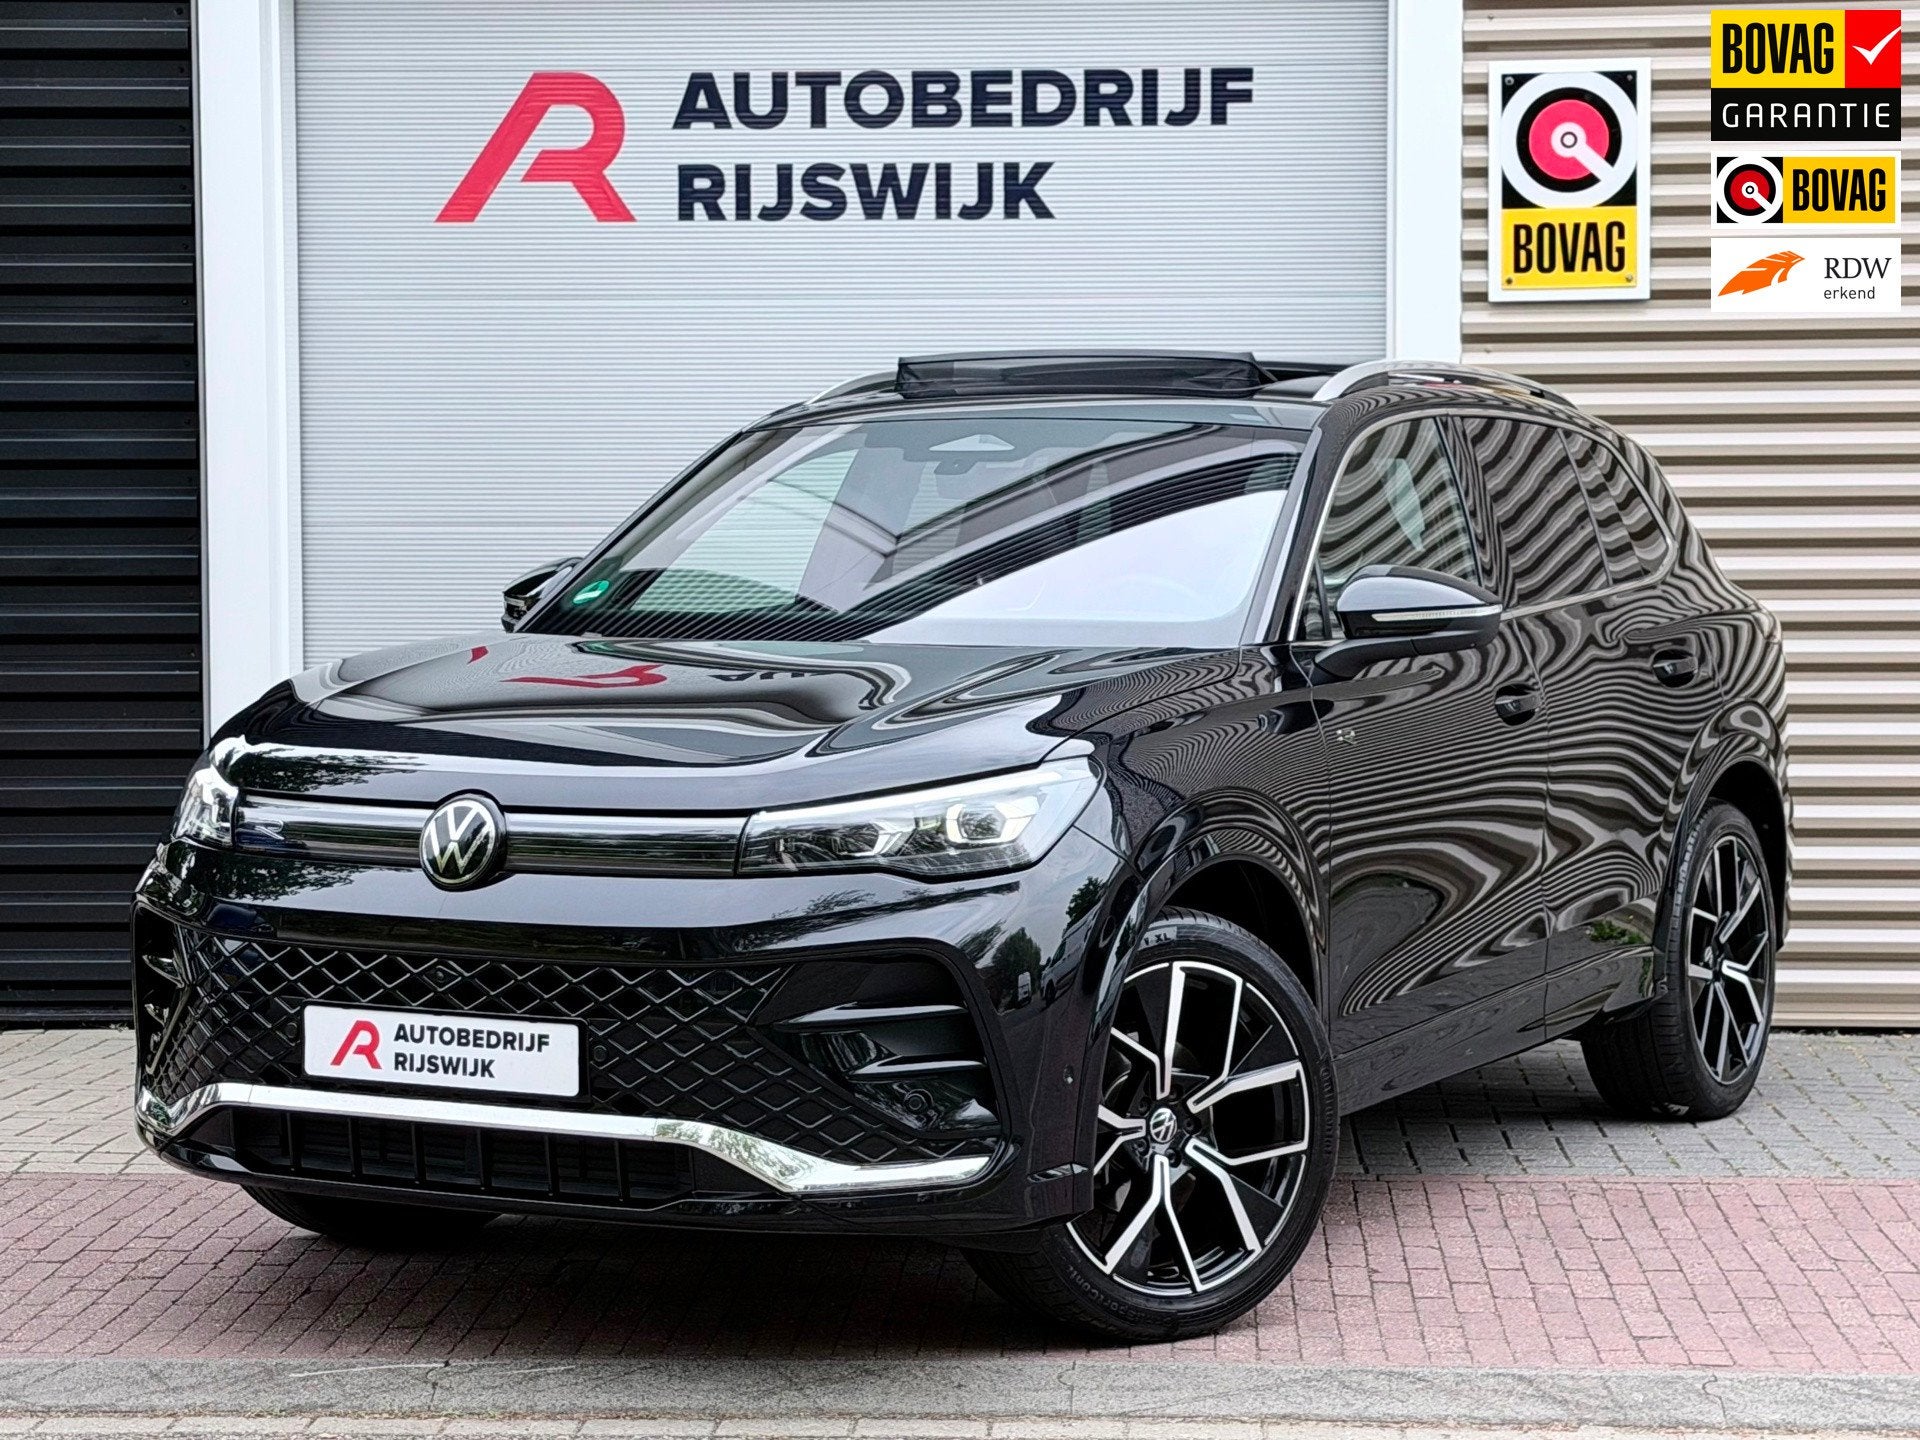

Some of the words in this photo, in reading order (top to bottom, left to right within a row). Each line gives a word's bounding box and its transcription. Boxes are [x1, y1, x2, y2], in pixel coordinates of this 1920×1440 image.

[672, 67, 1254, 129] AUTOBEDRIJF
[677, 161, 1056, 222] RIJSWIJK
[1513, 220, 1626, 274] BOVAG
[394, 1023, 550, 1053] AUTOBEDRIJF
[394, 1052, 495, 1078] RIJSWIJK
